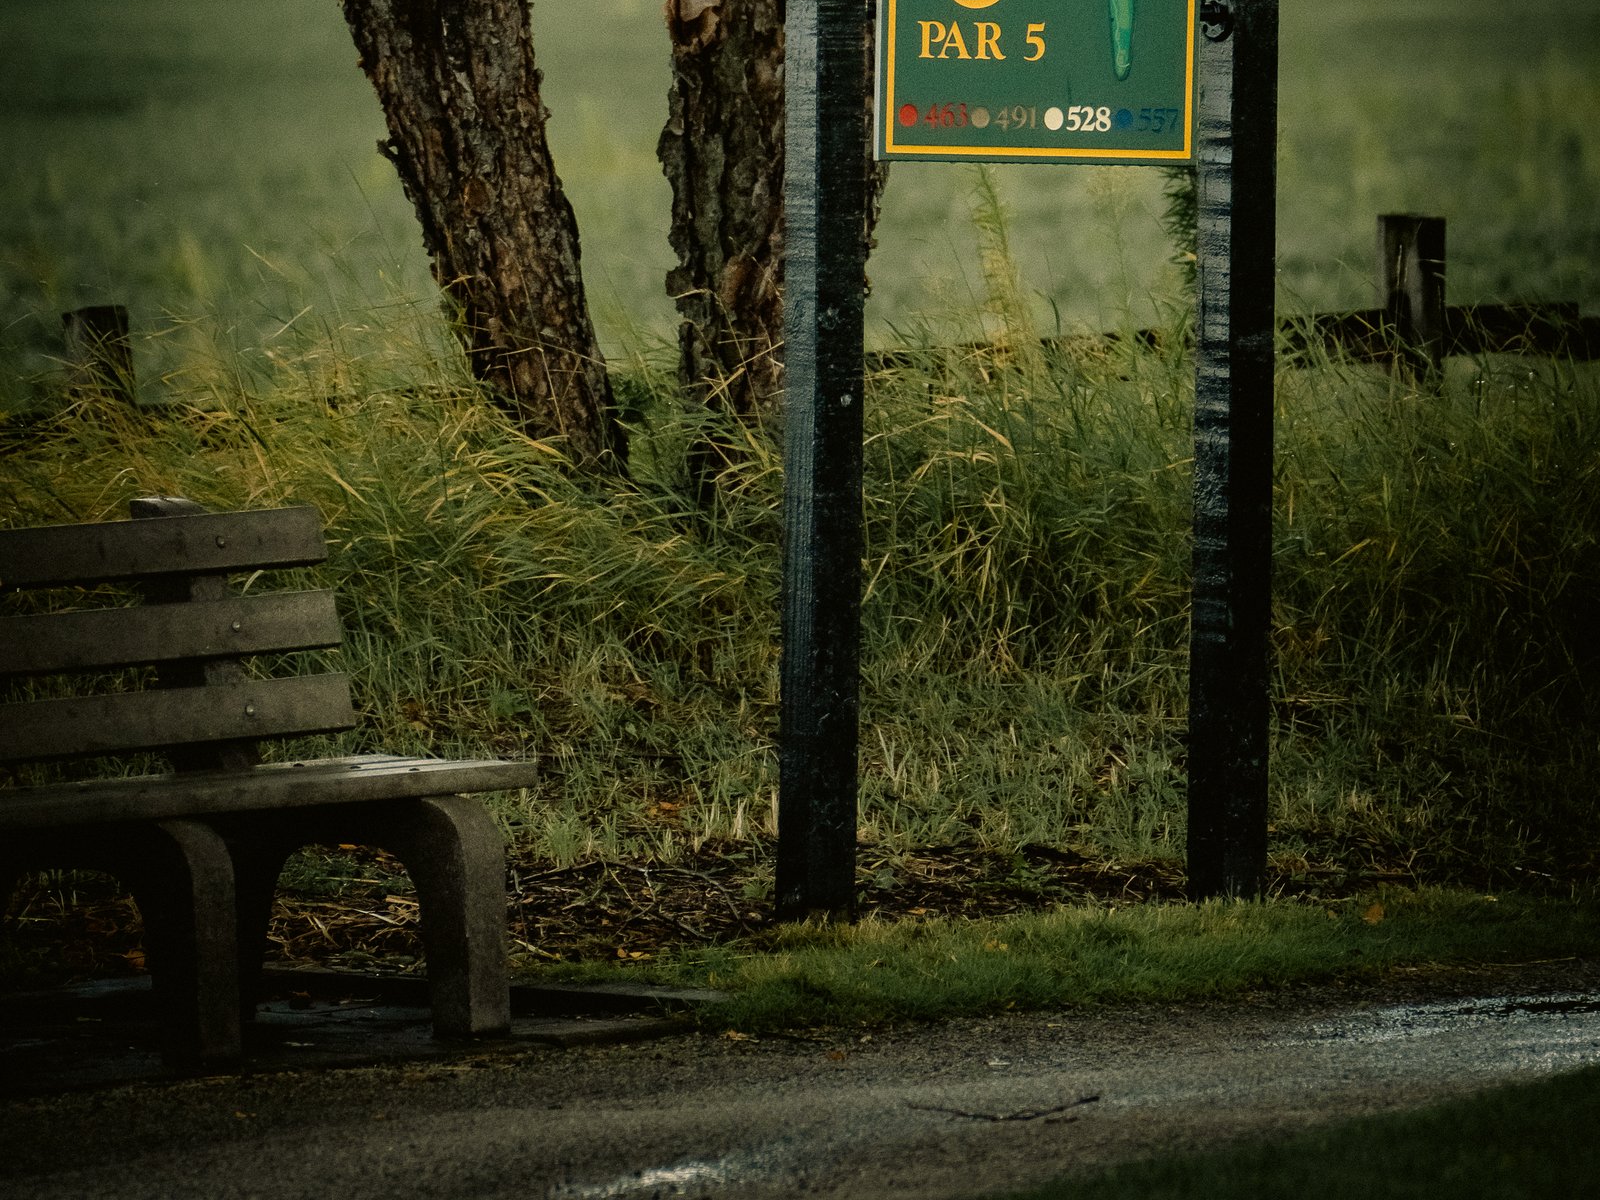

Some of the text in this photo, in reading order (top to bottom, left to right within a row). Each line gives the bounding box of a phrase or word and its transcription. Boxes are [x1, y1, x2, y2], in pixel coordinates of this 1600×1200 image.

[917, 20, 1046, 61] PAR 5
[923, 103, 1178, 133] 463 491 528 557
